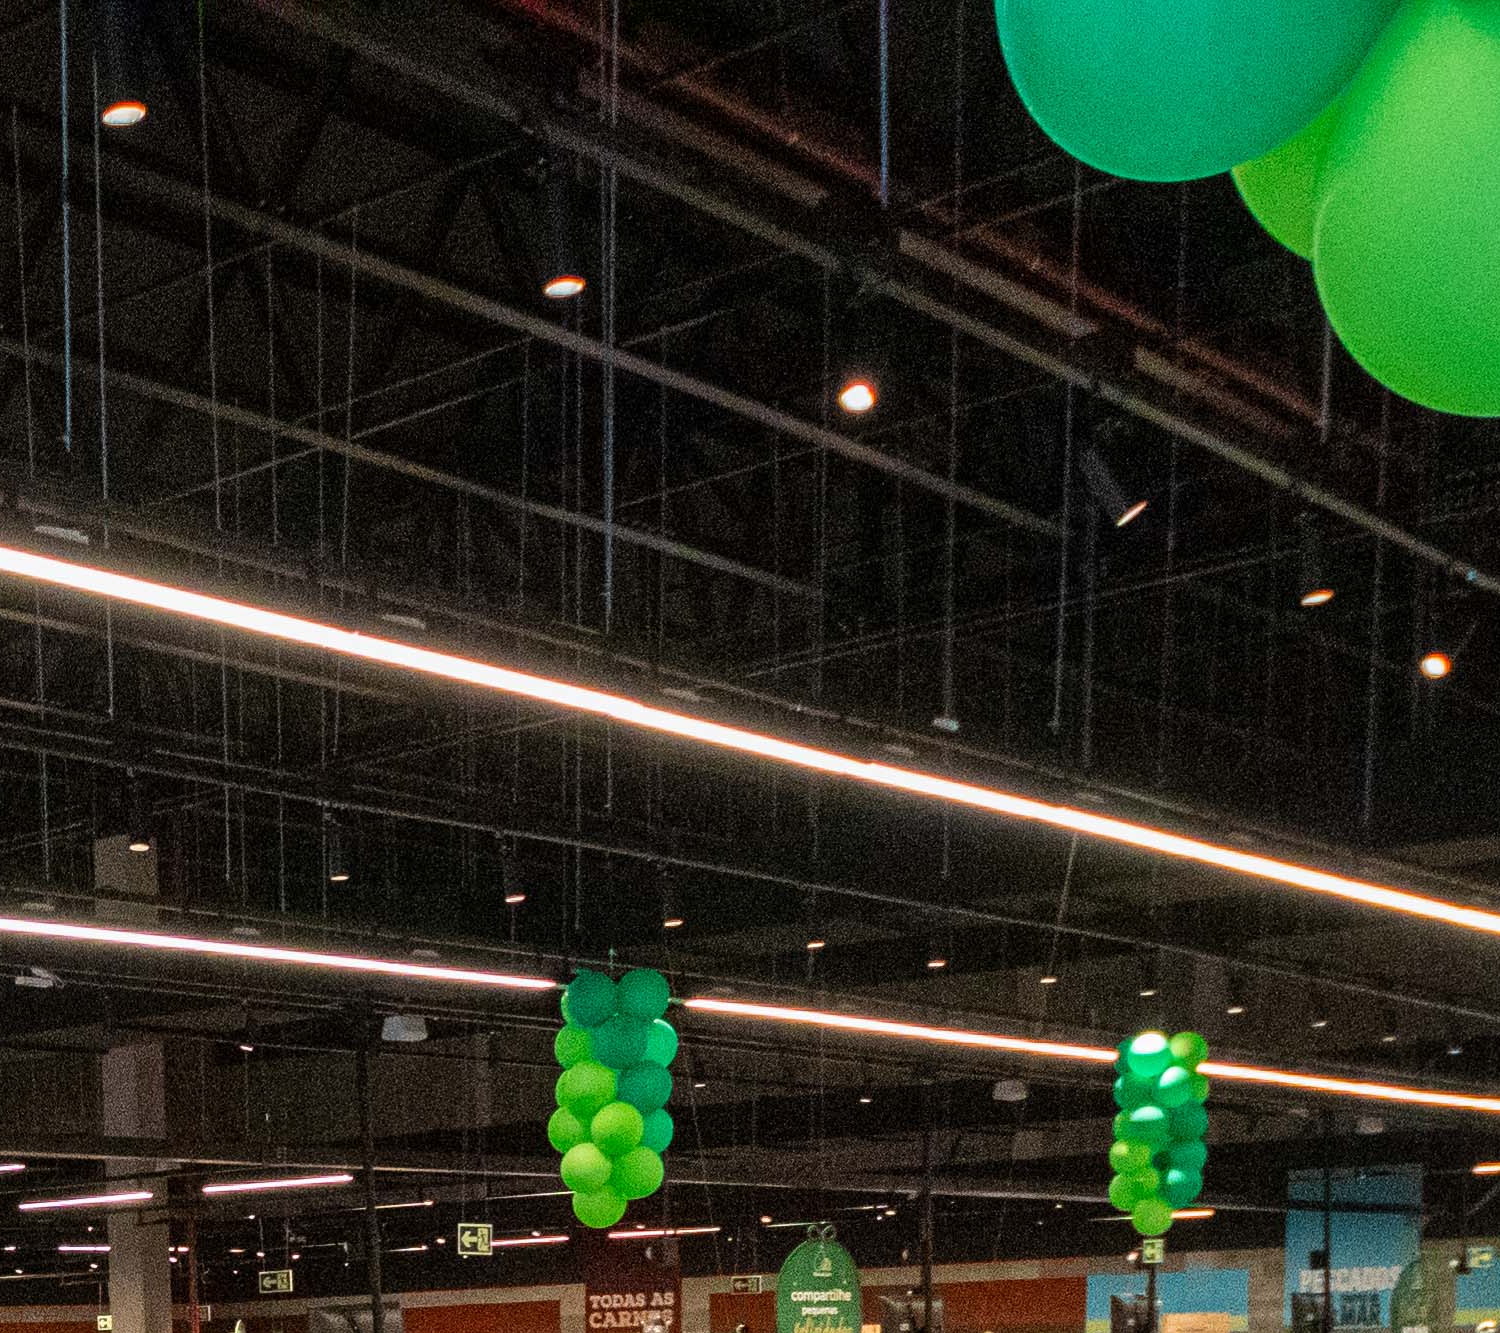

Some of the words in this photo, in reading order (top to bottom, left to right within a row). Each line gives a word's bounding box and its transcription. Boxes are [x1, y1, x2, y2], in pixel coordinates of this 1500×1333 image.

[590, 1295, 647, 1309] TODAS
[651, 1292, 675, 1306] AS
[792, 1289, 852, 1303] compartilhe
